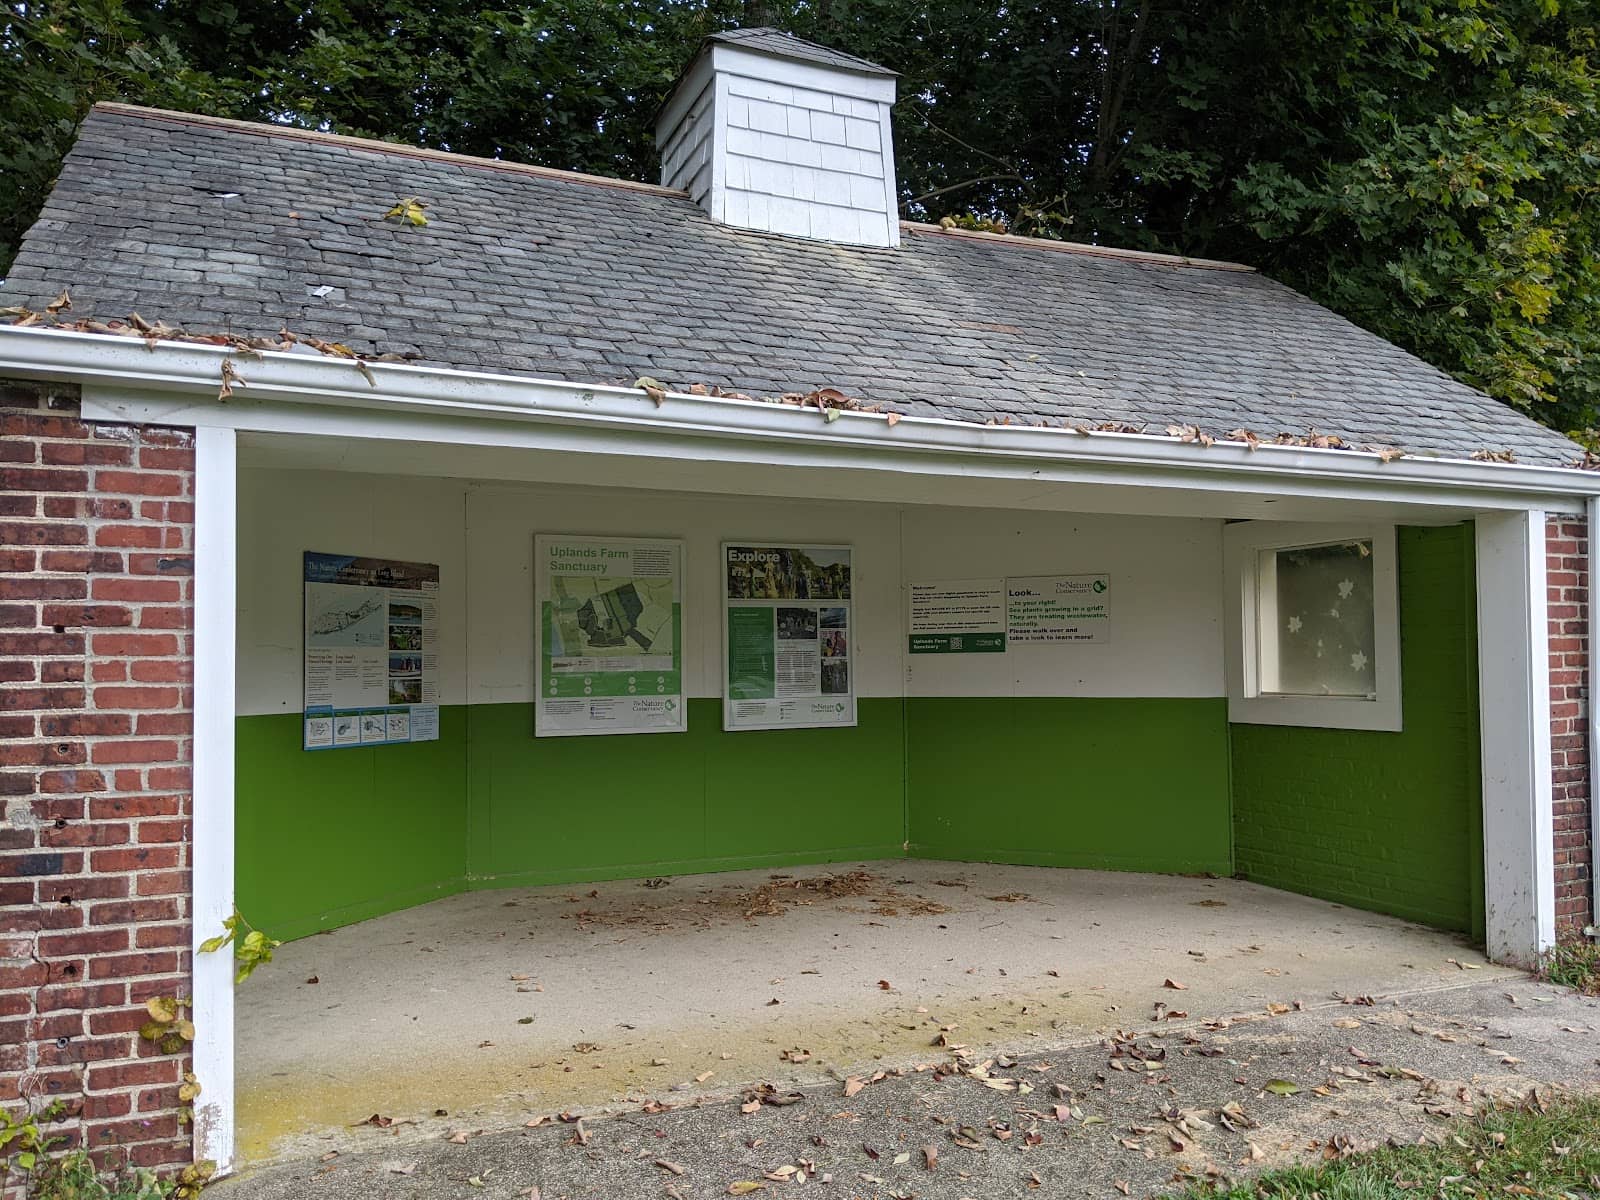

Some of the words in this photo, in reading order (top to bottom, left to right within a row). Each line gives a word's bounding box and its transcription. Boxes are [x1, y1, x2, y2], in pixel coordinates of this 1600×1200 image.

[550, 546, 597, 559] Uplands
[600, 548, 629, 559] Farm
[728, 550, 780, 564] Explore
[550, 560, 607, 574] Sanctuary
[377, 568, 390, 578] Long
[390, 568, 404, 577] Island
[1065, 581, 1092, 589] Nature
[1009, 589, 1040, 597] Look...
[641, 699, 664, 707] Nature
